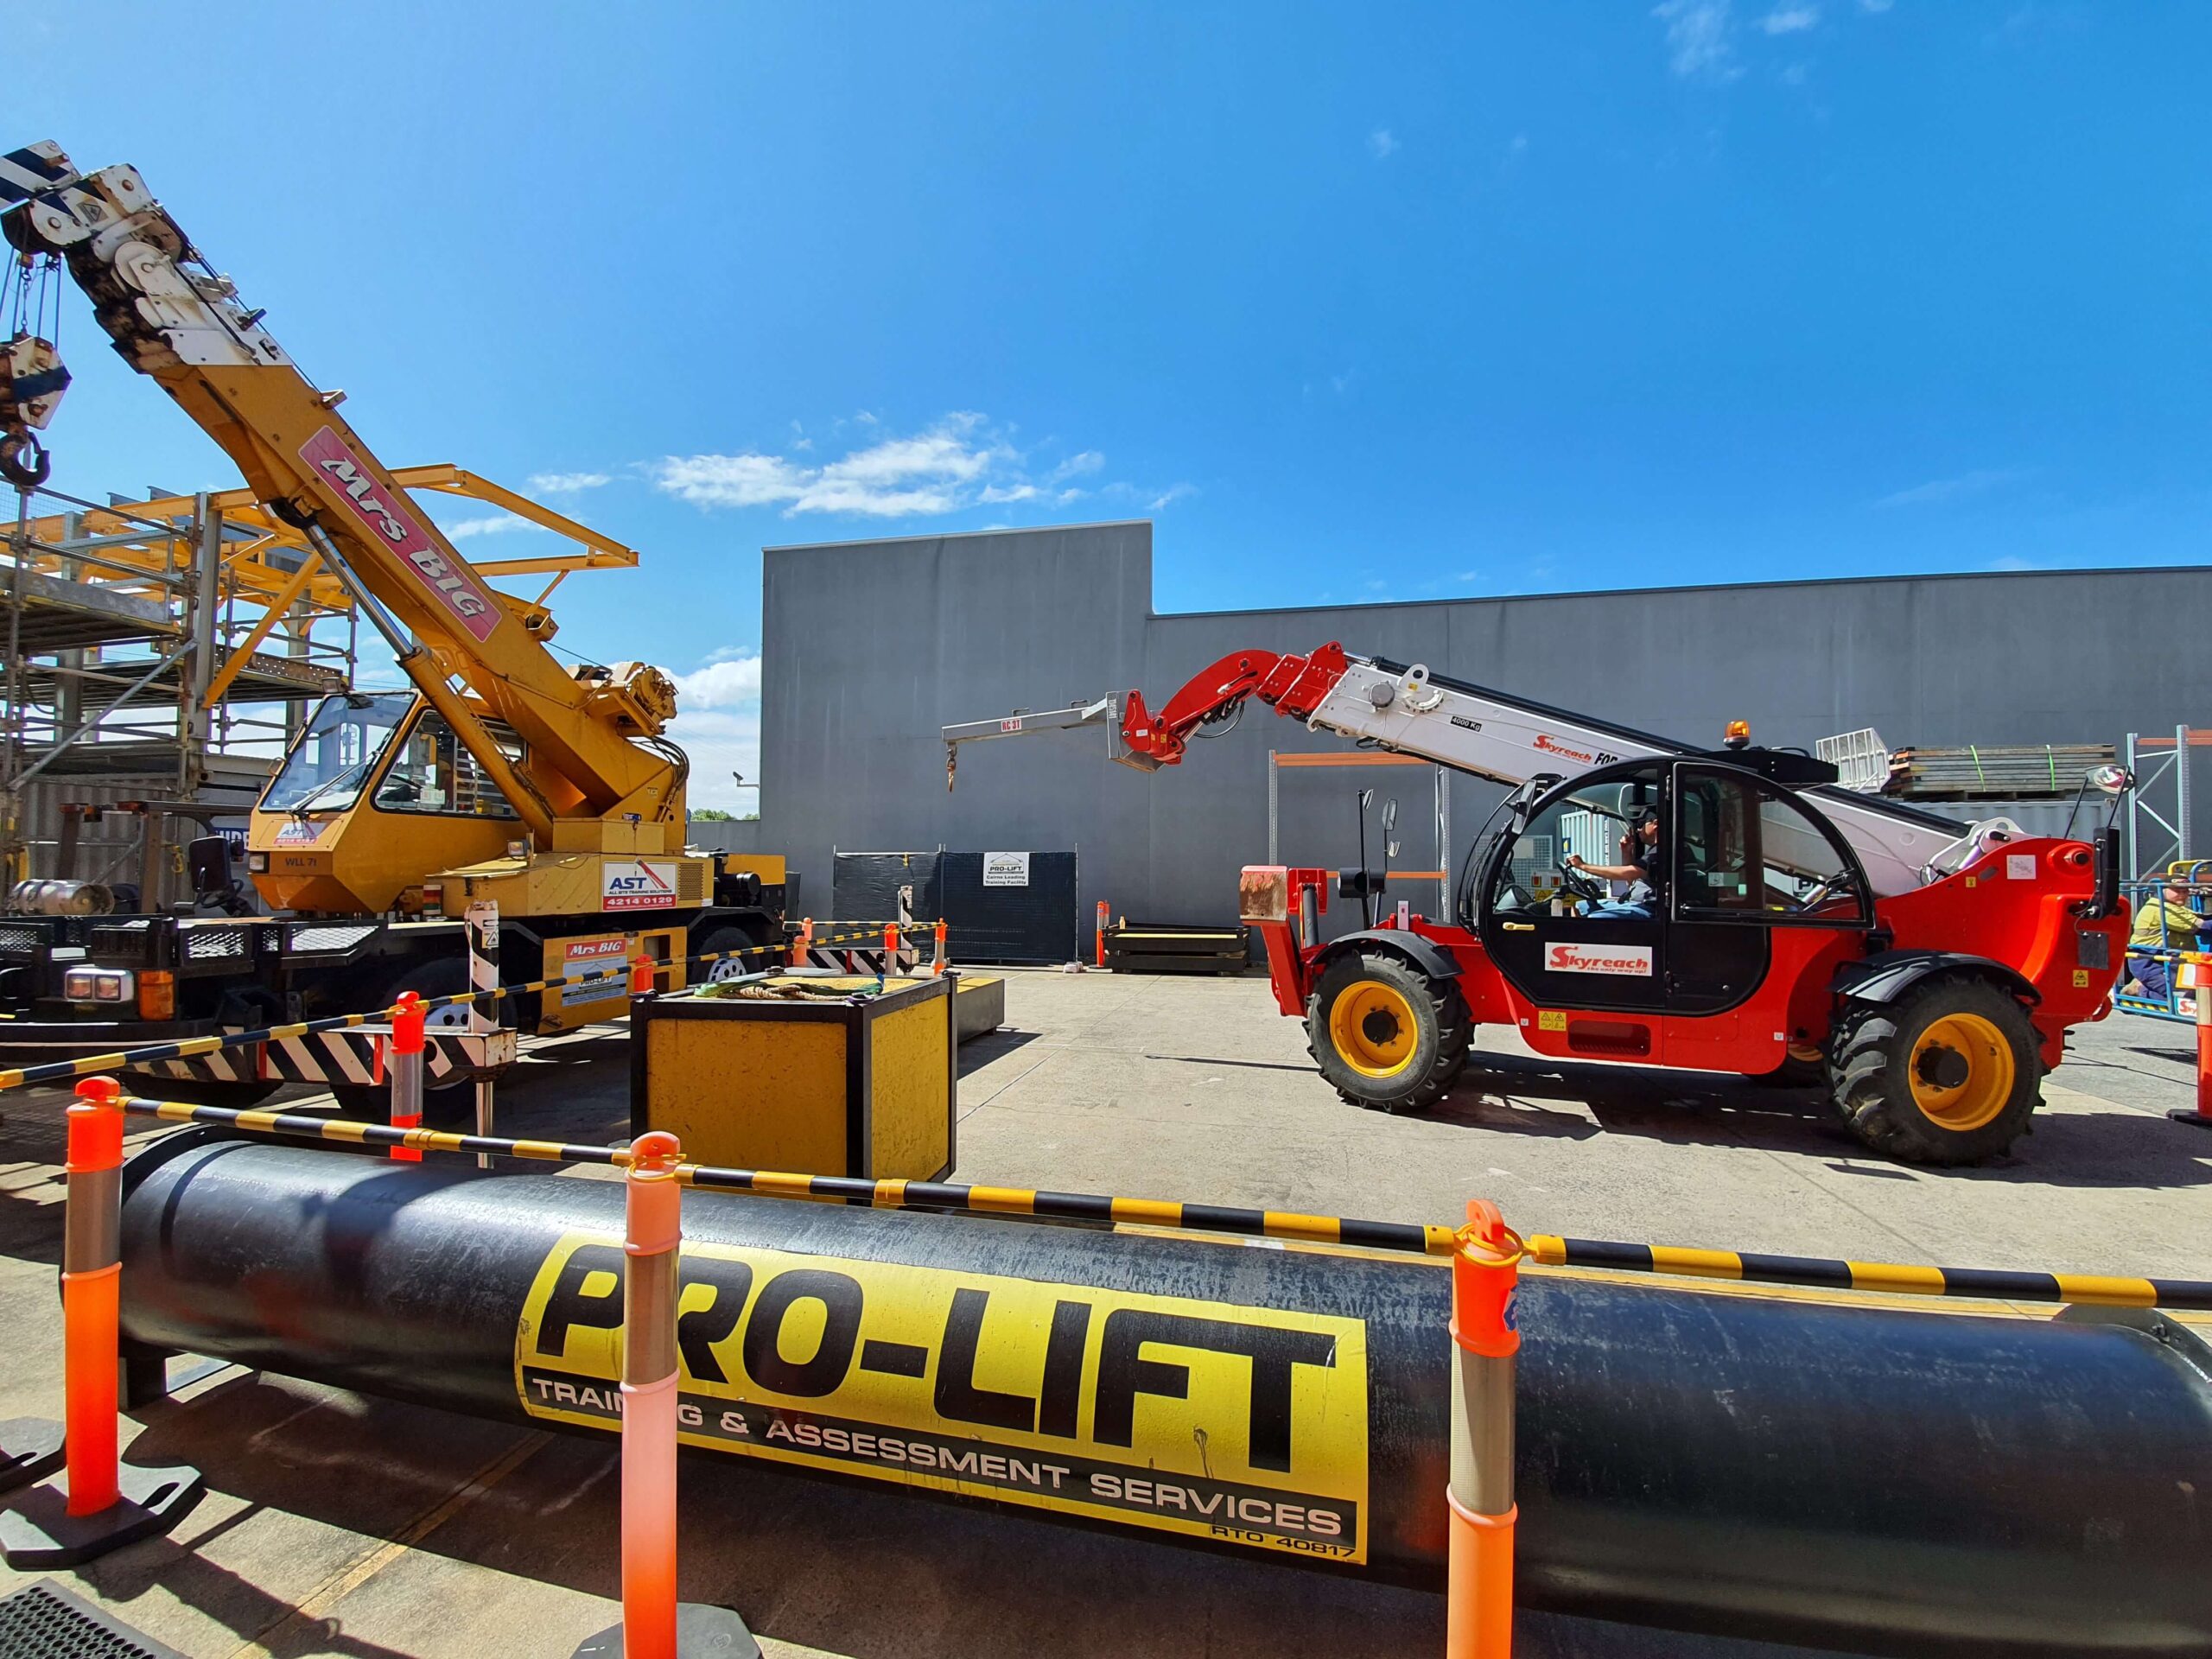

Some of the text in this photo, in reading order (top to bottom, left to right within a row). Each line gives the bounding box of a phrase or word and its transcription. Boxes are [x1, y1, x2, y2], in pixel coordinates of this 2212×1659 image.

[320, 456, 486, 619] Mrs BIG
[1452, 717, 1470, 727] 4000
[1533, 735, 1592, 760] Skyreach
[609, 877, 647, 890] AST
[570, 941, 622, 956] Mrs BIG
[1549, 946, 1649, 969] Skyreach
[536, 1244, 1336, 1473] PRO-LIFT
[532, 1377, 1341, 1535] TRAIG & ASSESSMENT SERVICES
[1211, 1525, 1356, 1558] RTO 40817
